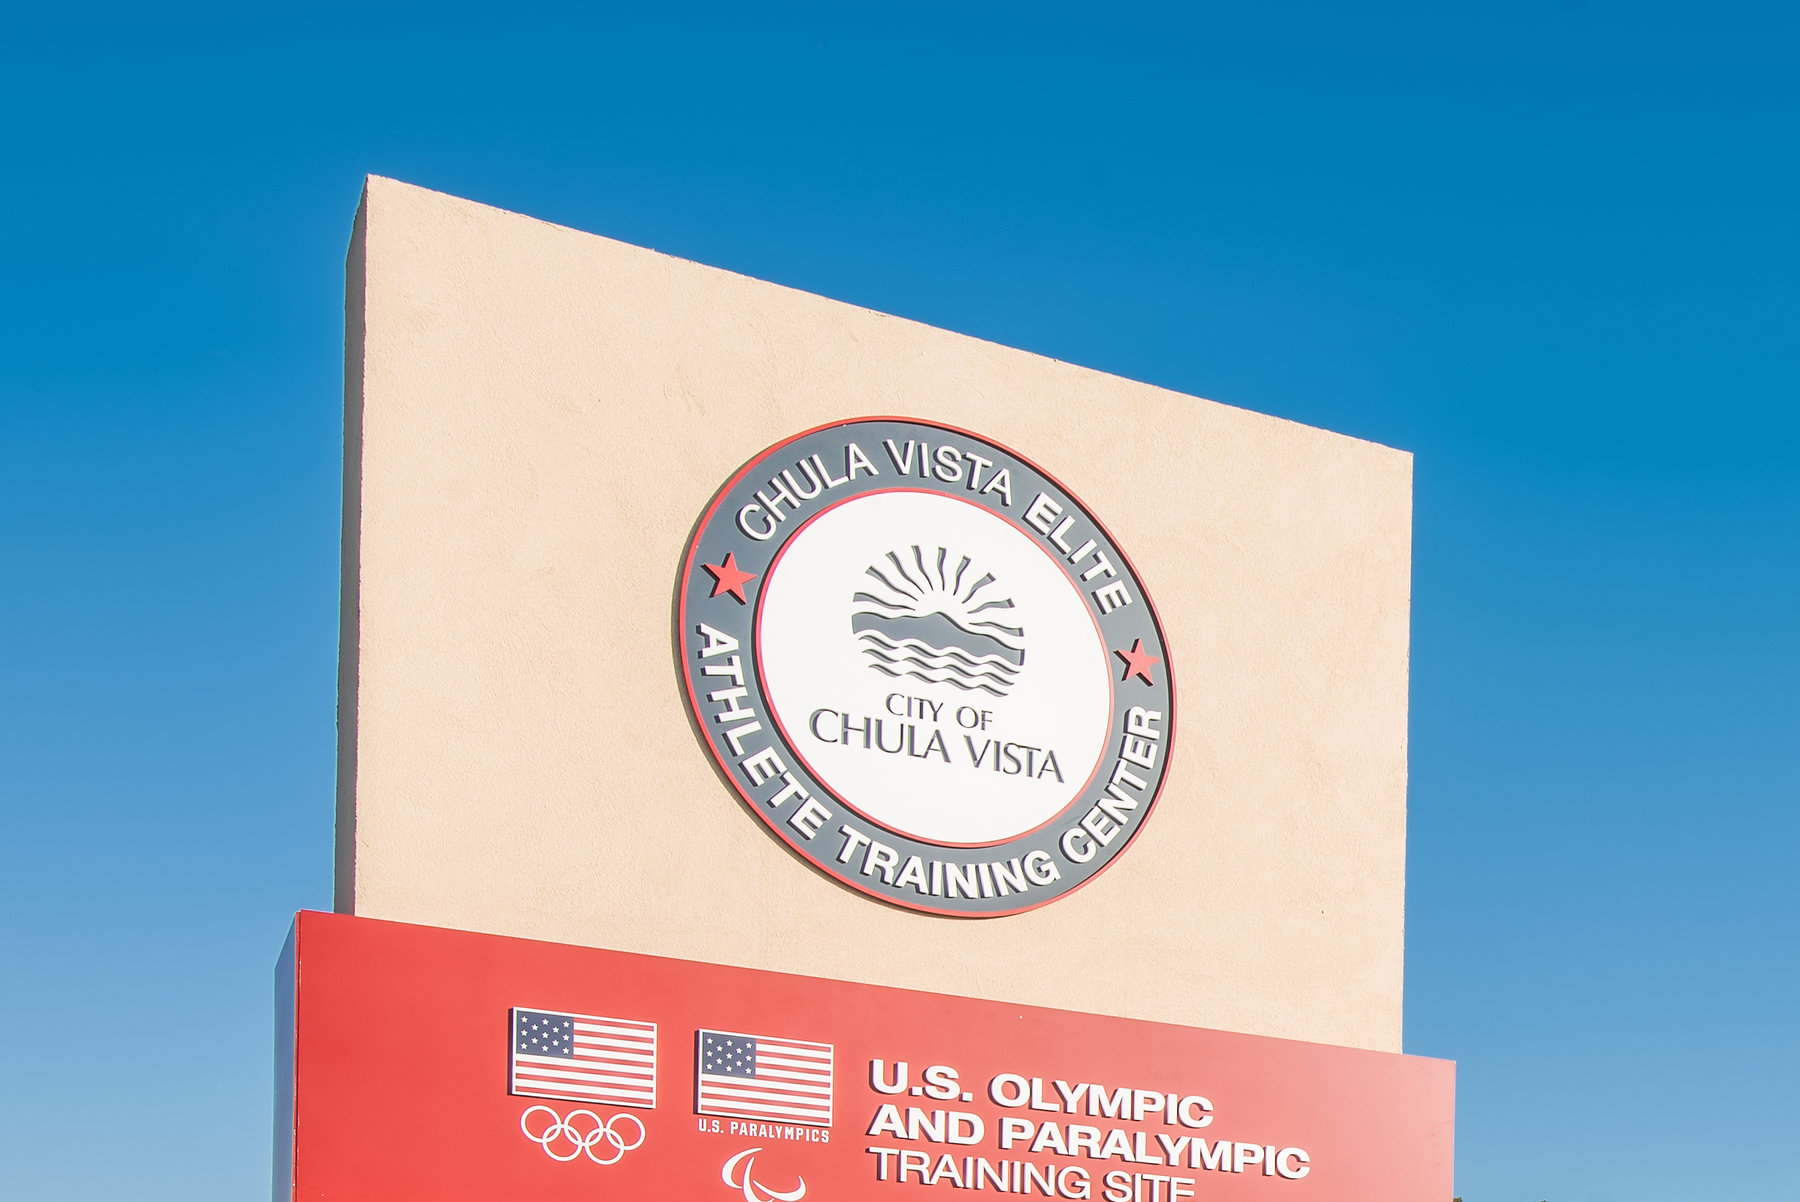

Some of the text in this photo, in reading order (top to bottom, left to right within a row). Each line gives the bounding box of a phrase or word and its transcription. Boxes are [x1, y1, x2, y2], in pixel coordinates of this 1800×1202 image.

[737, 438, 1134, 616] CHULA VISTA ELITE
[808, 707, 1065, 784] CHULA VISTA
[885, 692, 994, 731] CITY OF
[696, 622, 1163, 900] ATHLETE TRAINING CENTER
[697, 1117, 831, 1144] U.S. PARALYMPICS
[868, 1058, 1215, 1129] U.S. OLYMPIC
[866, 1102, 1313, 1181] AND PARALYMPIC
[867, 1145, 1092, 1201] TRAINING
